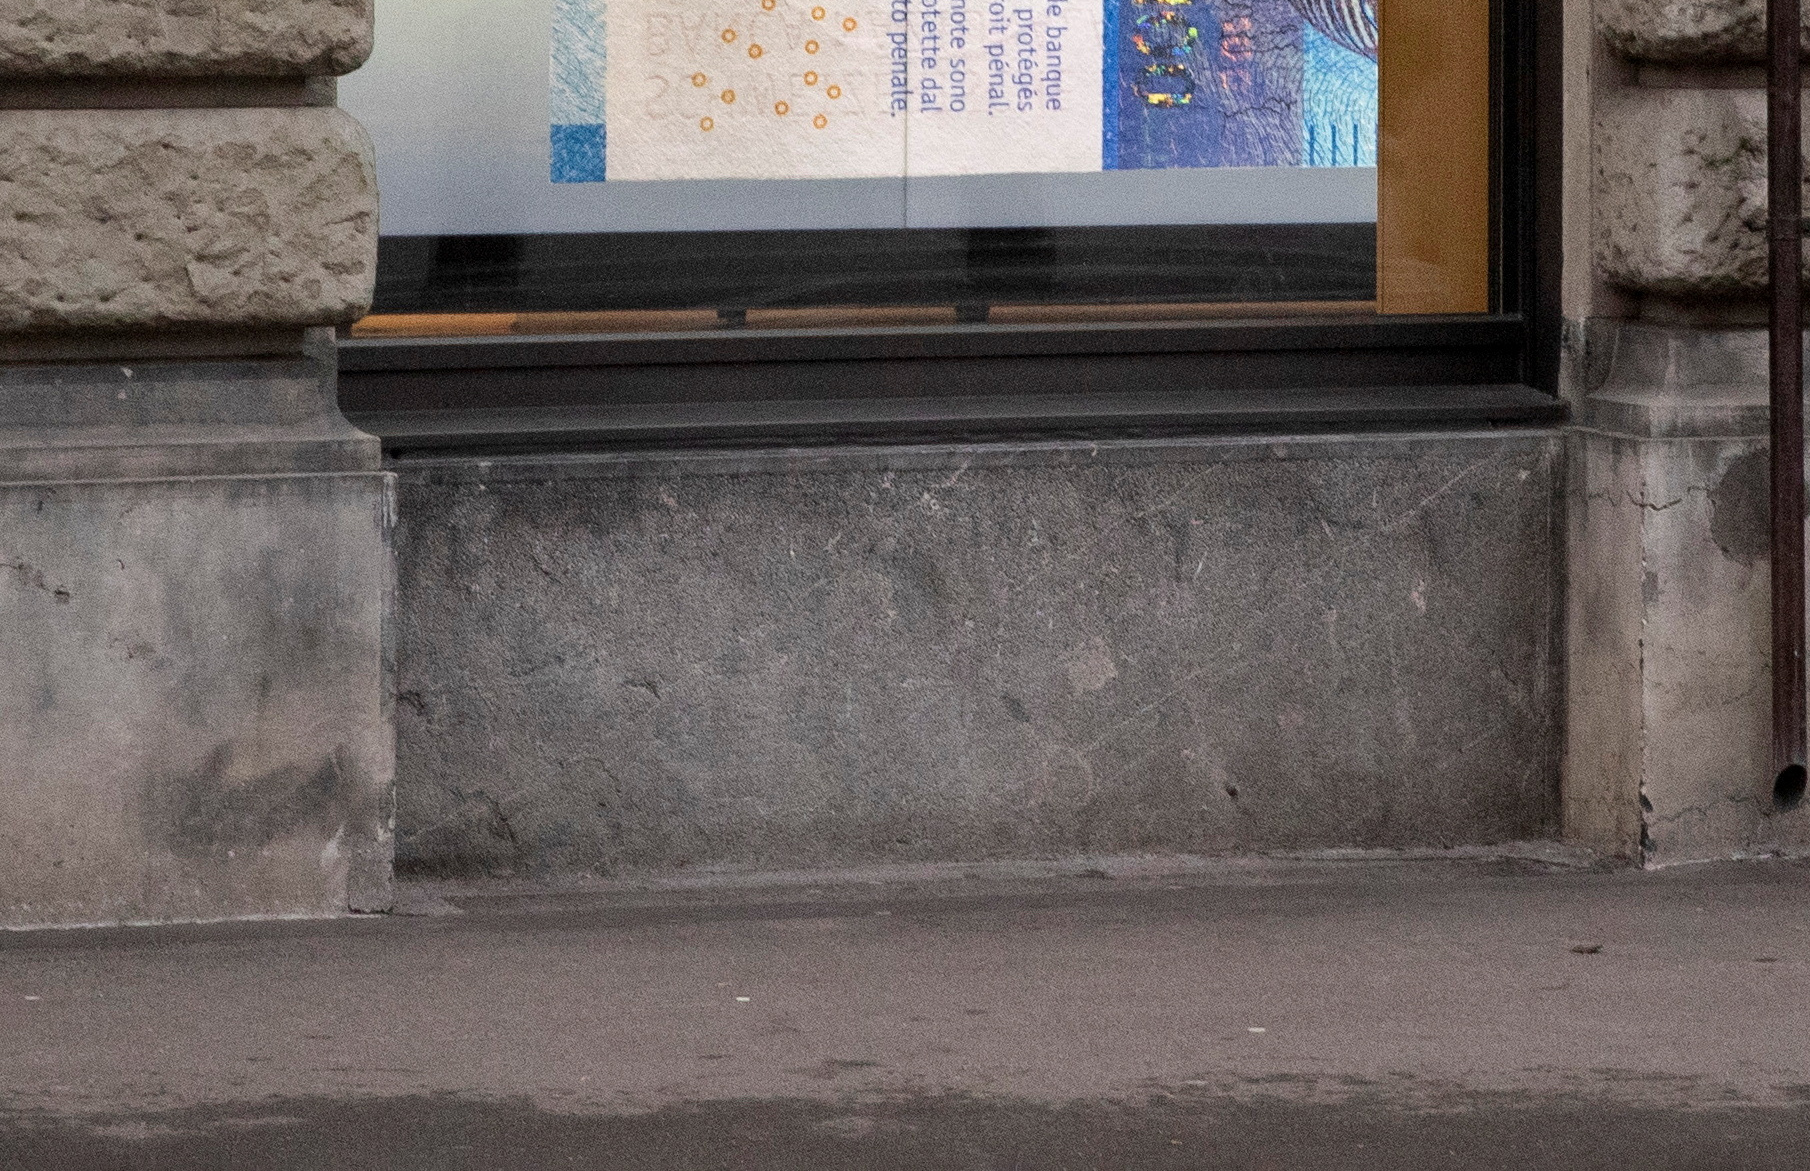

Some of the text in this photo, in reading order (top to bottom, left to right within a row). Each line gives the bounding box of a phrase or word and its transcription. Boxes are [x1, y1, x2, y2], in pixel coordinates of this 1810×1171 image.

[886, 31, 914, 118] penale.
[920, 77, 943, 114] dal
[949, 58, 967, 113] sono
[982, 44, 1010, 117] pénal.
[1011, 8, 1039, 112] protégés
[1040, 26, 1069, 111] banque
